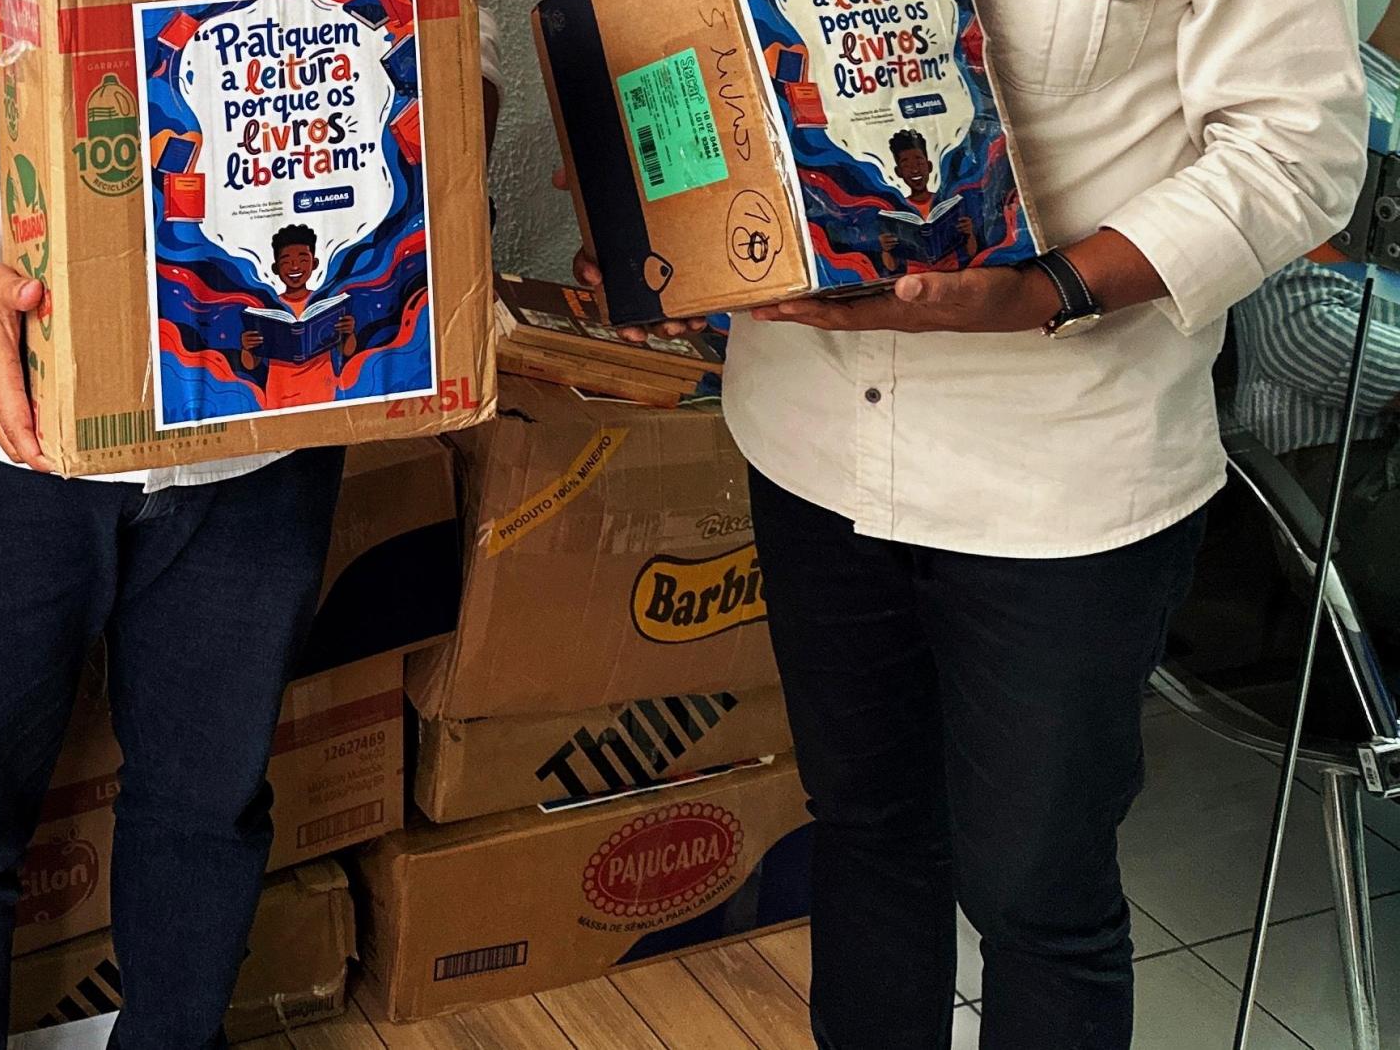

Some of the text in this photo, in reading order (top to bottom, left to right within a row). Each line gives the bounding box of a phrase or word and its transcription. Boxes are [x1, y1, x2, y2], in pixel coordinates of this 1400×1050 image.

[819, 1, 929, 44] porque os
[839, 25, 929, 65] livros
[87, 61, 130, 71] GARRAFA
[221, 70, 239, 91] a
[224, 85, 355, 132] porque os
[237, 112, 346, 155] livros
[72, 137, 141, 171] 100
[313, 193, 349, 203] ALAGOAS
[498, 435, 612, 540] PRODUTO 100% MINEIRO
[645, 558, 764, 627] Barbi
[323, 730, 386, 761] 12627469
[578, 916, 607, 932] MASSA
[609, 923, 624, 932] DE
[665, 906, 692, 921] PARA
